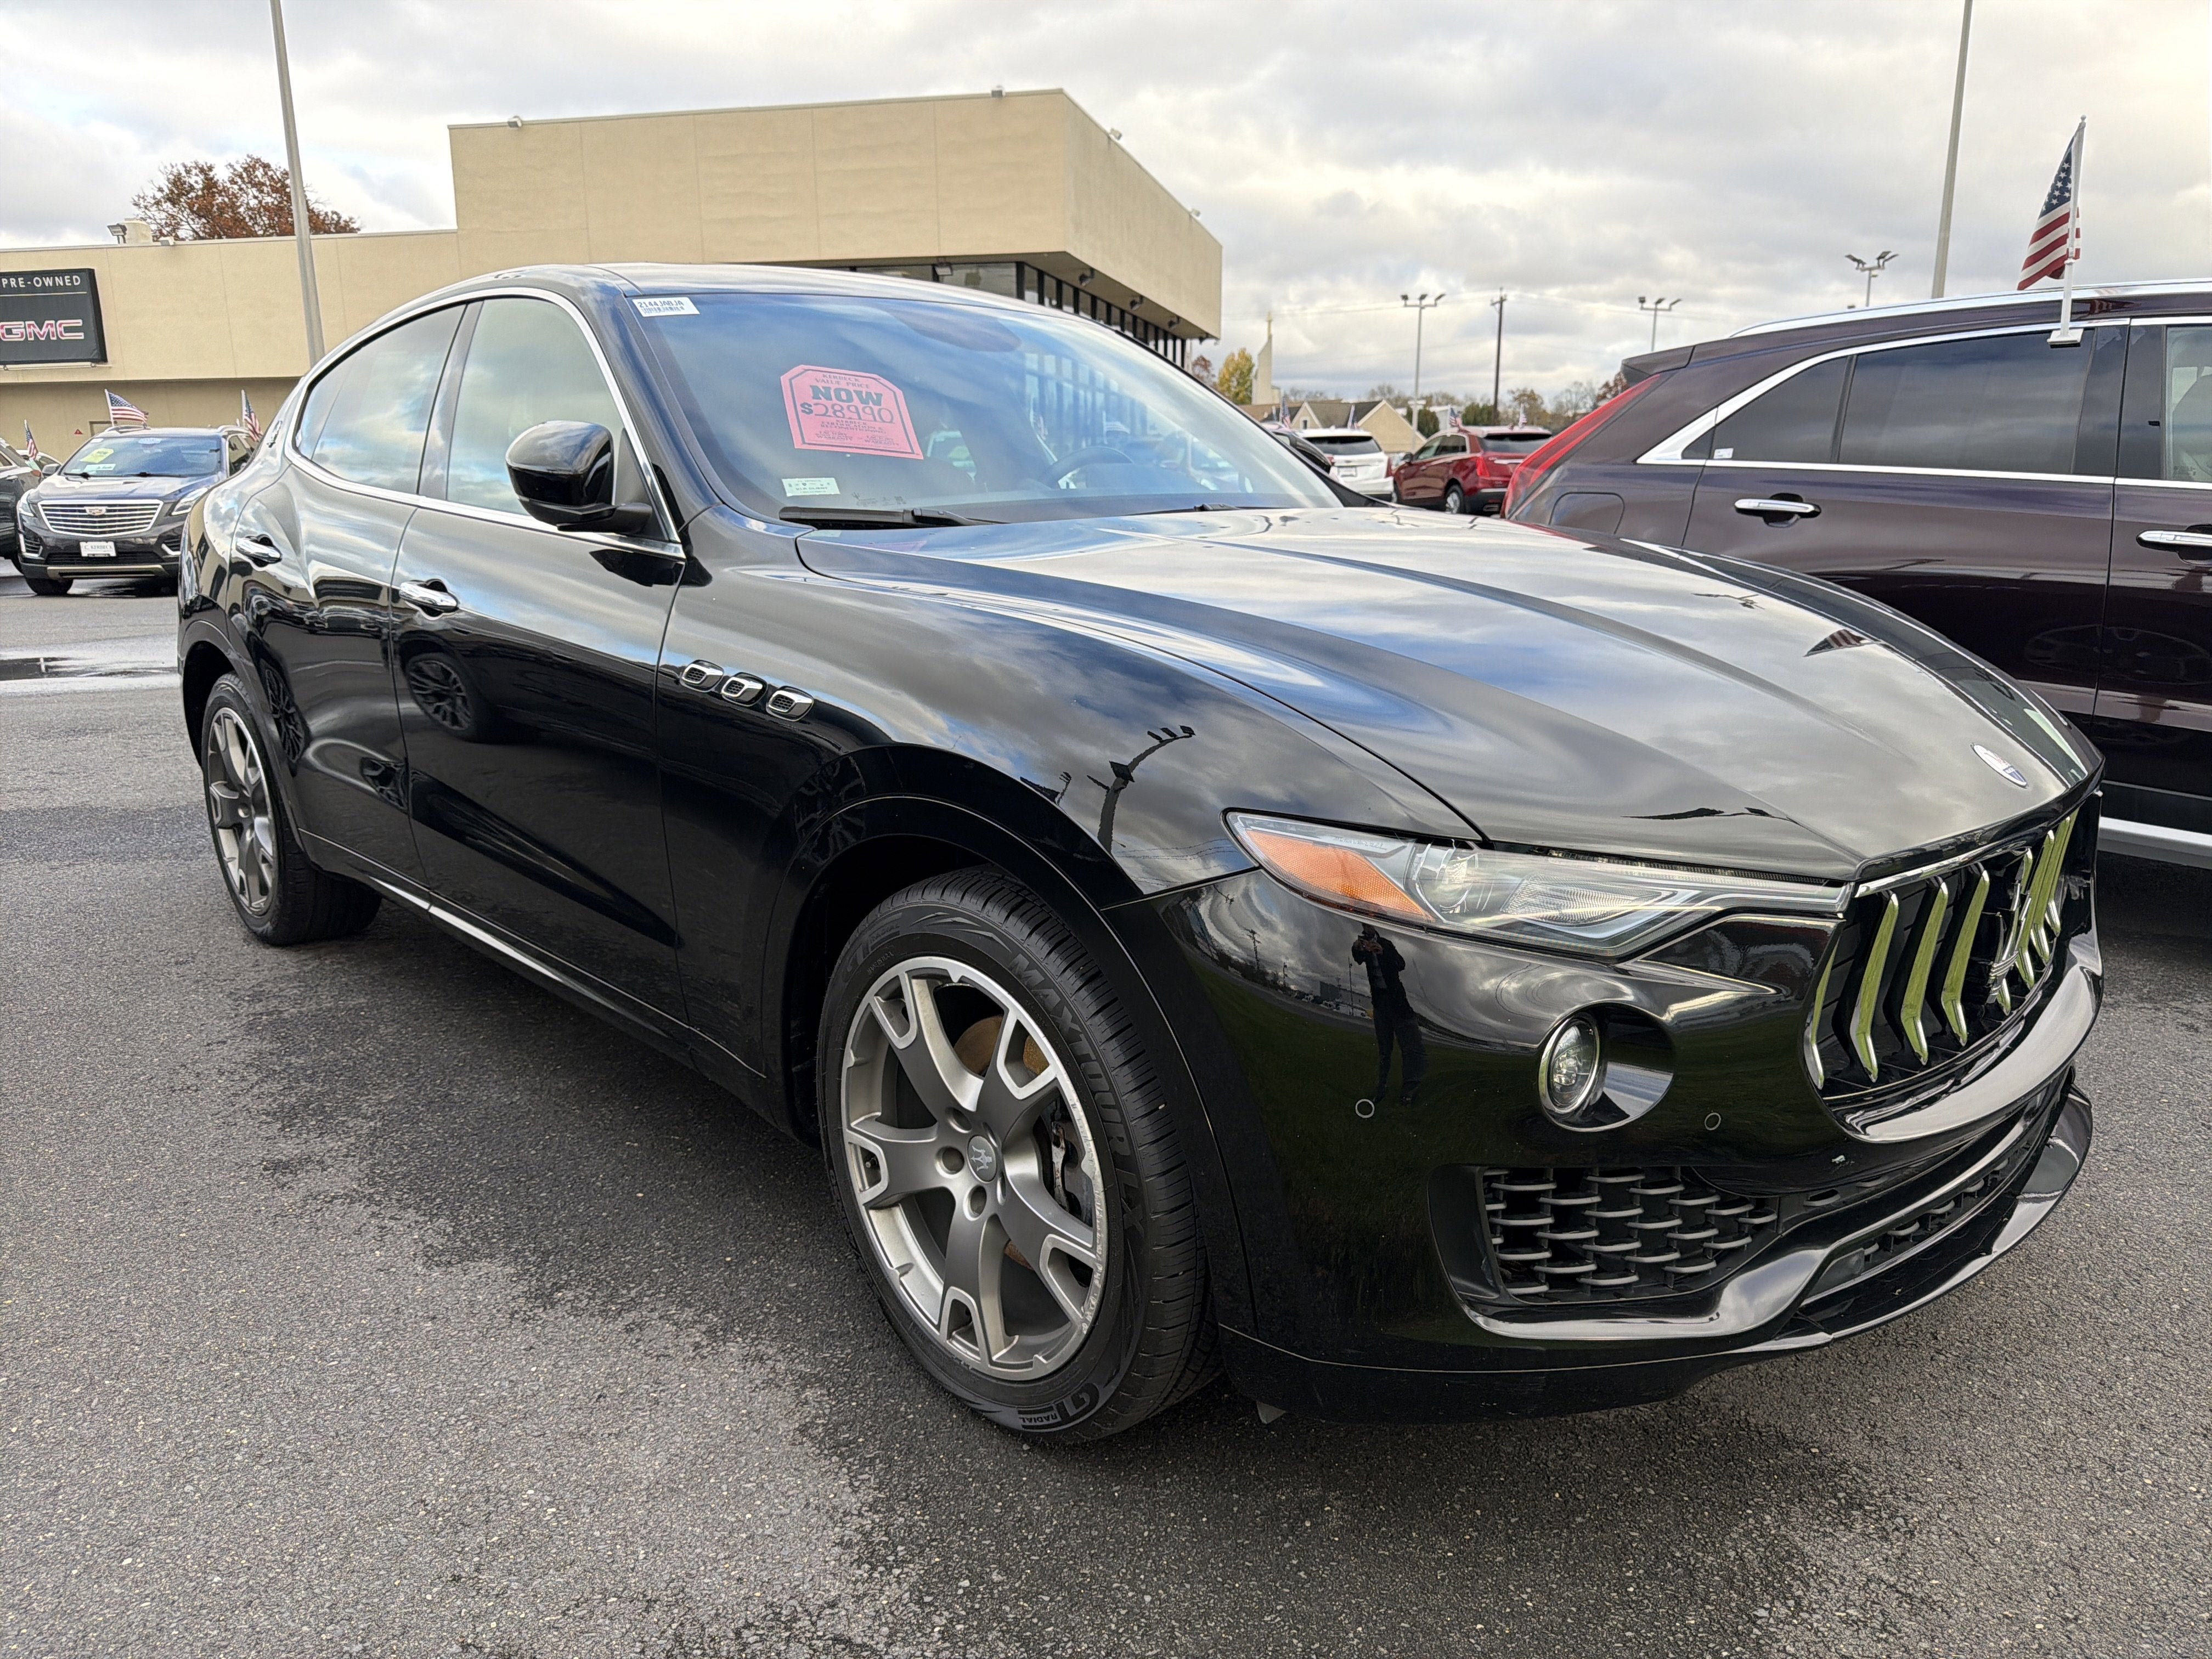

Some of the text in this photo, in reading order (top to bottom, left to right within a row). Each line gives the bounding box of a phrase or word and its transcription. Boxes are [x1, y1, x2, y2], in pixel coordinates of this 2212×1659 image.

[2, 275, 81, 288] PRE-OWNED
[0, 319, 84, 341] GMC
[822, 374, 860, 382] KERBECK
[810, 385, 883, 407] NOW
[1008, 952, 1146, 1239] MAXTOUR LX
[1019, 1412, 1058, 1424] RADIAL
